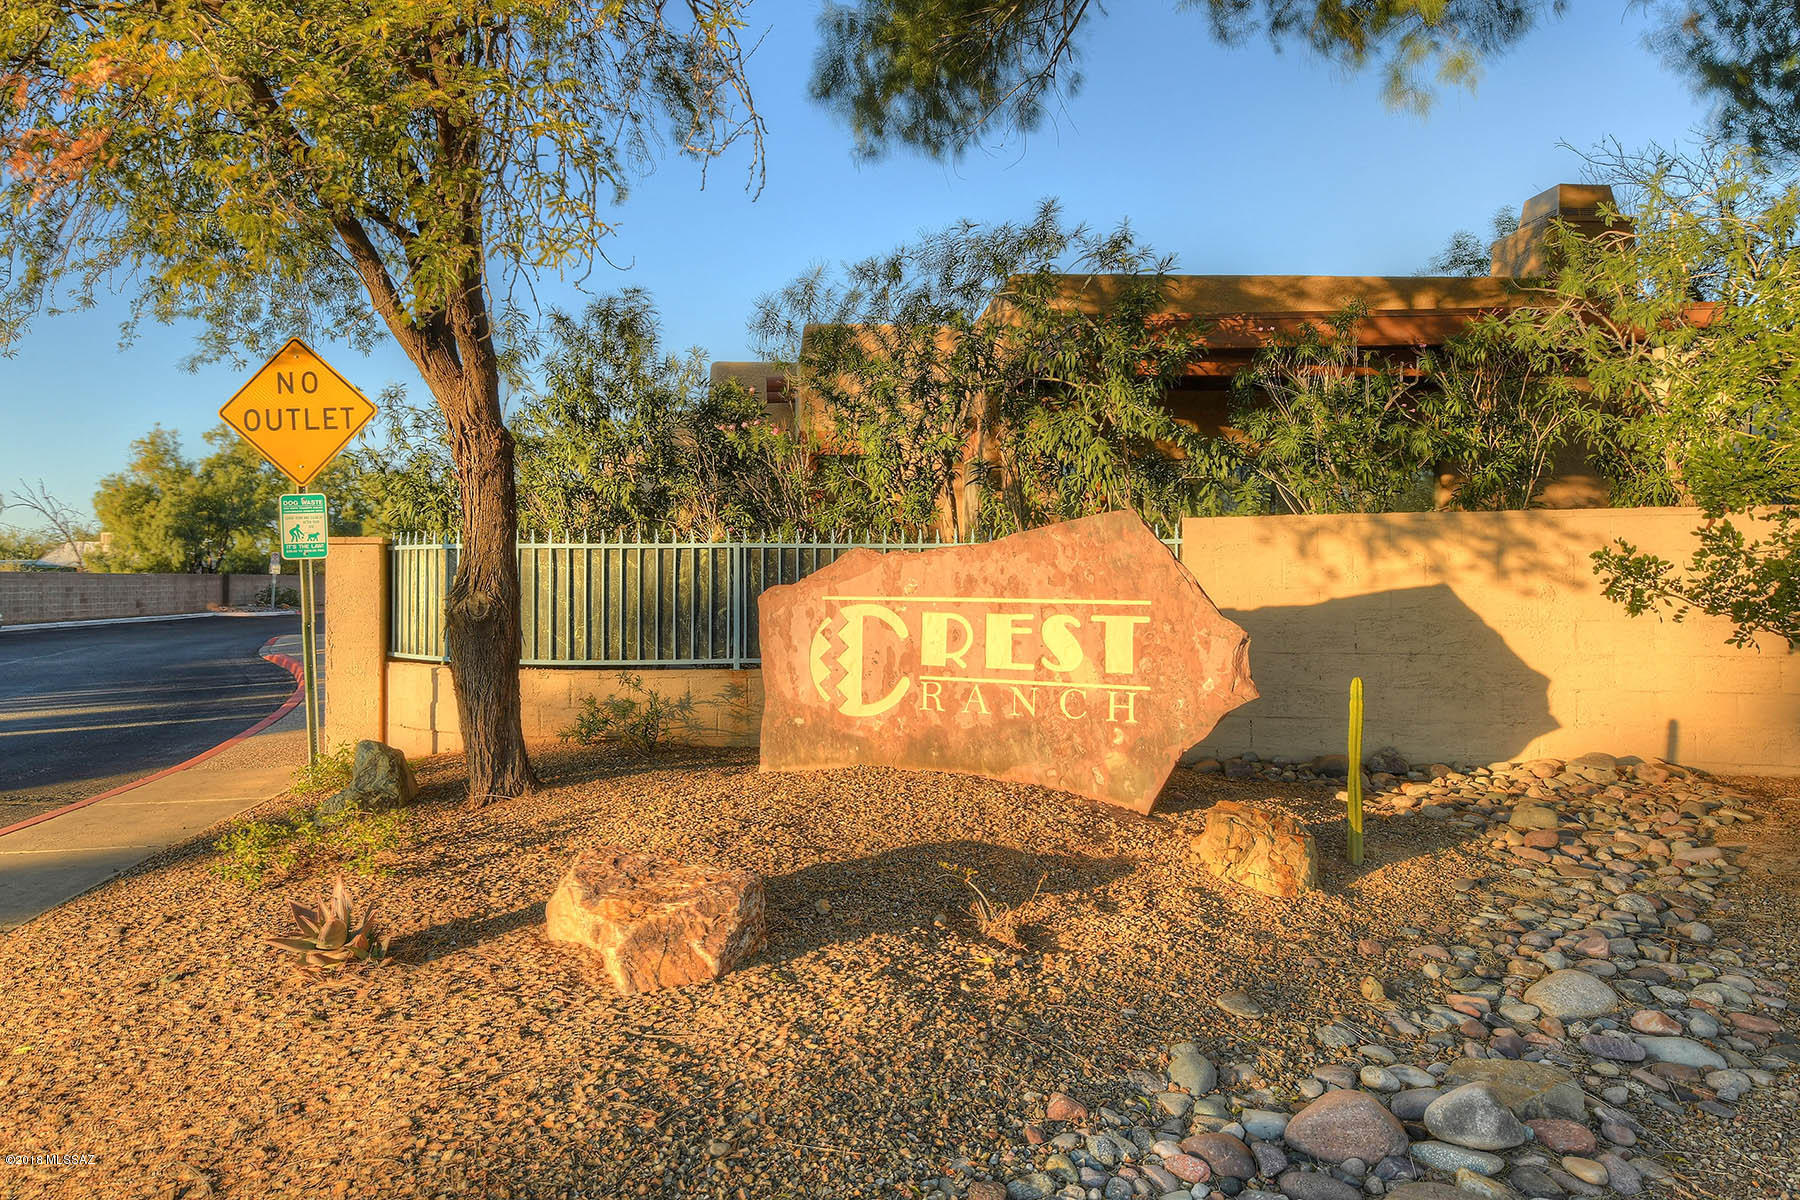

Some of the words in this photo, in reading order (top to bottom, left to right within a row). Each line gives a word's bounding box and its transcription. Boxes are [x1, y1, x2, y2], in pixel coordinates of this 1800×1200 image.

[276, 371, 318, 394] NO
[243, 407, 355, 432] OUTLET
[919, 681, 1138, 724] RANCH
